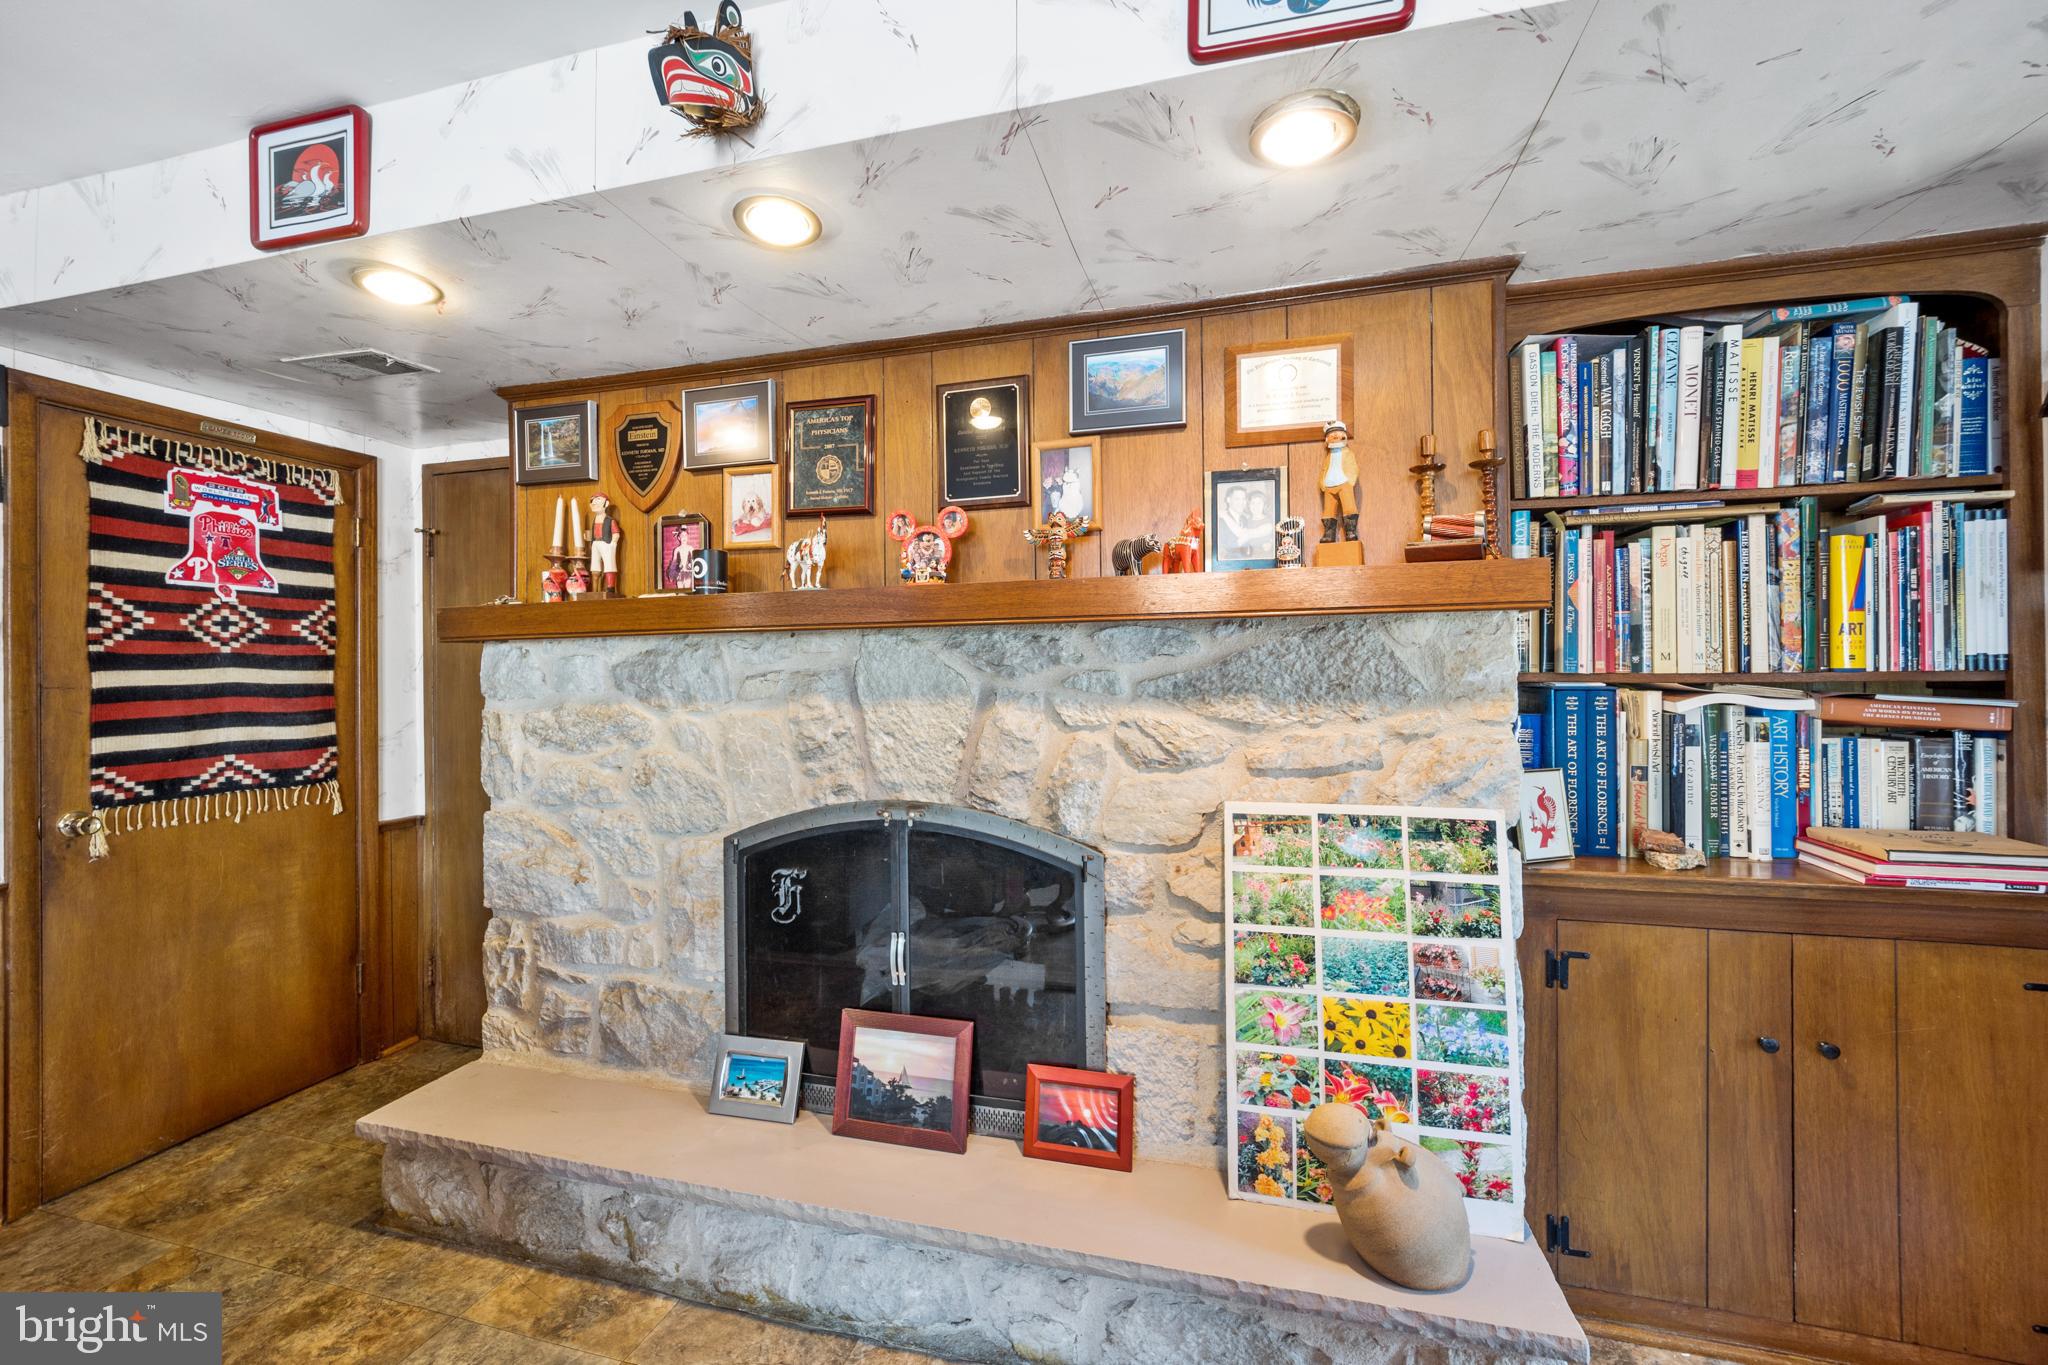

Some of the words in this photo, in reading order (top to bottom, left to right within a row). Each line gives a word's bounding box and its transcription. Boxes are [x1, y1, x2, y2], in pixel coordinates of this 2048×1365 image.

[1887, 331, 1897, 357] WORKS
[1902, 320, 1912, 358] NORMAN
[1529, 352, 1539, 388] GASTON
[1570, 342, 1578, 403] IMPRESSIONISM
[1600, 356, 1610, 386] Essential
[1633, 347, 1641, 383] VINCENT
[1716, 366, 1725, 379] THE
[1728, 339, 1739, 403] MATISSE
[1783, 350, 1798, 389] Renoir
[1837, 359, 1851, 391] 1000
[1855, 369, 1865, 384] THE
[1632, 383, 1640, 392] by
[1684, 364, 1699, 420] MONET
[1749, 371, 1758, 400] HENRI
[1885, 372, 1896, 386] ART
[1900, 360, 1910, 413] ROCKWELL'S
[1992, 370, 2000, 391] History
[1530, 391, 1540, 417] DIEHL
[1561, 368, 1570, 431] IMPRESSIONISM
[1601, 386, 1612, 406] VAN
[1632, 393, 1641, 418] Himself
[1716, 381, 1724, 406] BEAUTY
[1816, 382, 1825, 406] Country
[1854, 386, 1865, 413] JEWISH
[1715, 407, 1723, 416] OF
[1836, 392, 1848, 438] MASTERPIECES
[1992, 397, 2000, 422] Medicine
[629, 431, 657, 440] Einstein
[811, 427, 849, 436] PHYSICIANS
[1531, 423, 1540, 439] THE
[1600, 408, 1612, 439] GOGH
[1714, 416, 1723, 445] STAINED
[1748, 404, 1757, 444] MATISSE
[1852, 415, 1864, 439] SPIRIT
[1898, 415, 1908, 454] AMERICA
[1886, 427, 1896, 457] HOVING
[1514, 439, 1523, 472] PICASSO
[1532, 443, 1542, 490] MODERNS
[1713, 445, 1722, 468] GLASS
[194, 485, 226, 496] WORLD
[227, 490, 258, 500] SERIES
[202, 493, 250, 506] CHAMPIONS
[199, 515, 253, 539] Phillies
[1741, 529, 1749, 547] THE
[217, 559, 259, 572] SERIES
[223, 555, 253, 564] WORLD
[1657, 537, 1672, 568] Degas
[1741, 547, 1749, 573] BIBLE
[187, 557, 209, 581] P
[1567, 553, 1575, 584] PICASSO
[1641, 556, 1651, 591] ATLAS
[1742, 572, 1750, 582] IN
[1742, 582, 1750, 619] STAINED
[1566, 610, 1575, 634] Things
[1743, 619, 1751, 646] GLASS
[1838, 622, 1864, 636] ART
[1567, 714, 1577, 737] THE
[1596, 714, 1607, 737] THE
[1652, 709, 1661, 737] Ancient
[1736, 719, 1746, 751] Jewish
[1773, 716, 1788, 742] ART
[1567, 738, 1577, 759] ART
[1596, 738, 1607, 760] ART
[1652, 737, 1661, 761] Jewish
[1709, 734, 1718, 781] WINSLOW
[1720, 750, 1728, 767] FREE
[1736, 751, 1745, 765] Art
[1567, 761, 1577, 776] OF
[1596, 762, 1607, 777] OF
[1652, 760, 1661, 774] Art
[1736, 766, 1746, 784] and
[1774, 744, 1789, 799] HISTORY
[1798, 747, 1810, 789] AMERICAN
[1887, 756, 1897, 788] CENTURY
[1897, 756, 1906, 799] TWENTIETH-
[1687, 759, 1697, 806] Cézanne
[1720, 770, 1728, 795] WITHIN
[1983, 773, 1993, 801] AMERICAN
[1568, 778, 1578, 834] FLORENCE
[1597, 778, 1608, 835] FLORENCE
[1710, 783, 1719, 819] HOMER
[1736, 784, 1746, 833] Civilization
[1888, 789, 1897, 805] ART
[1983, 801, 1993, 817] MIND
[1720, 797, 1728, 834] OURSELVES
